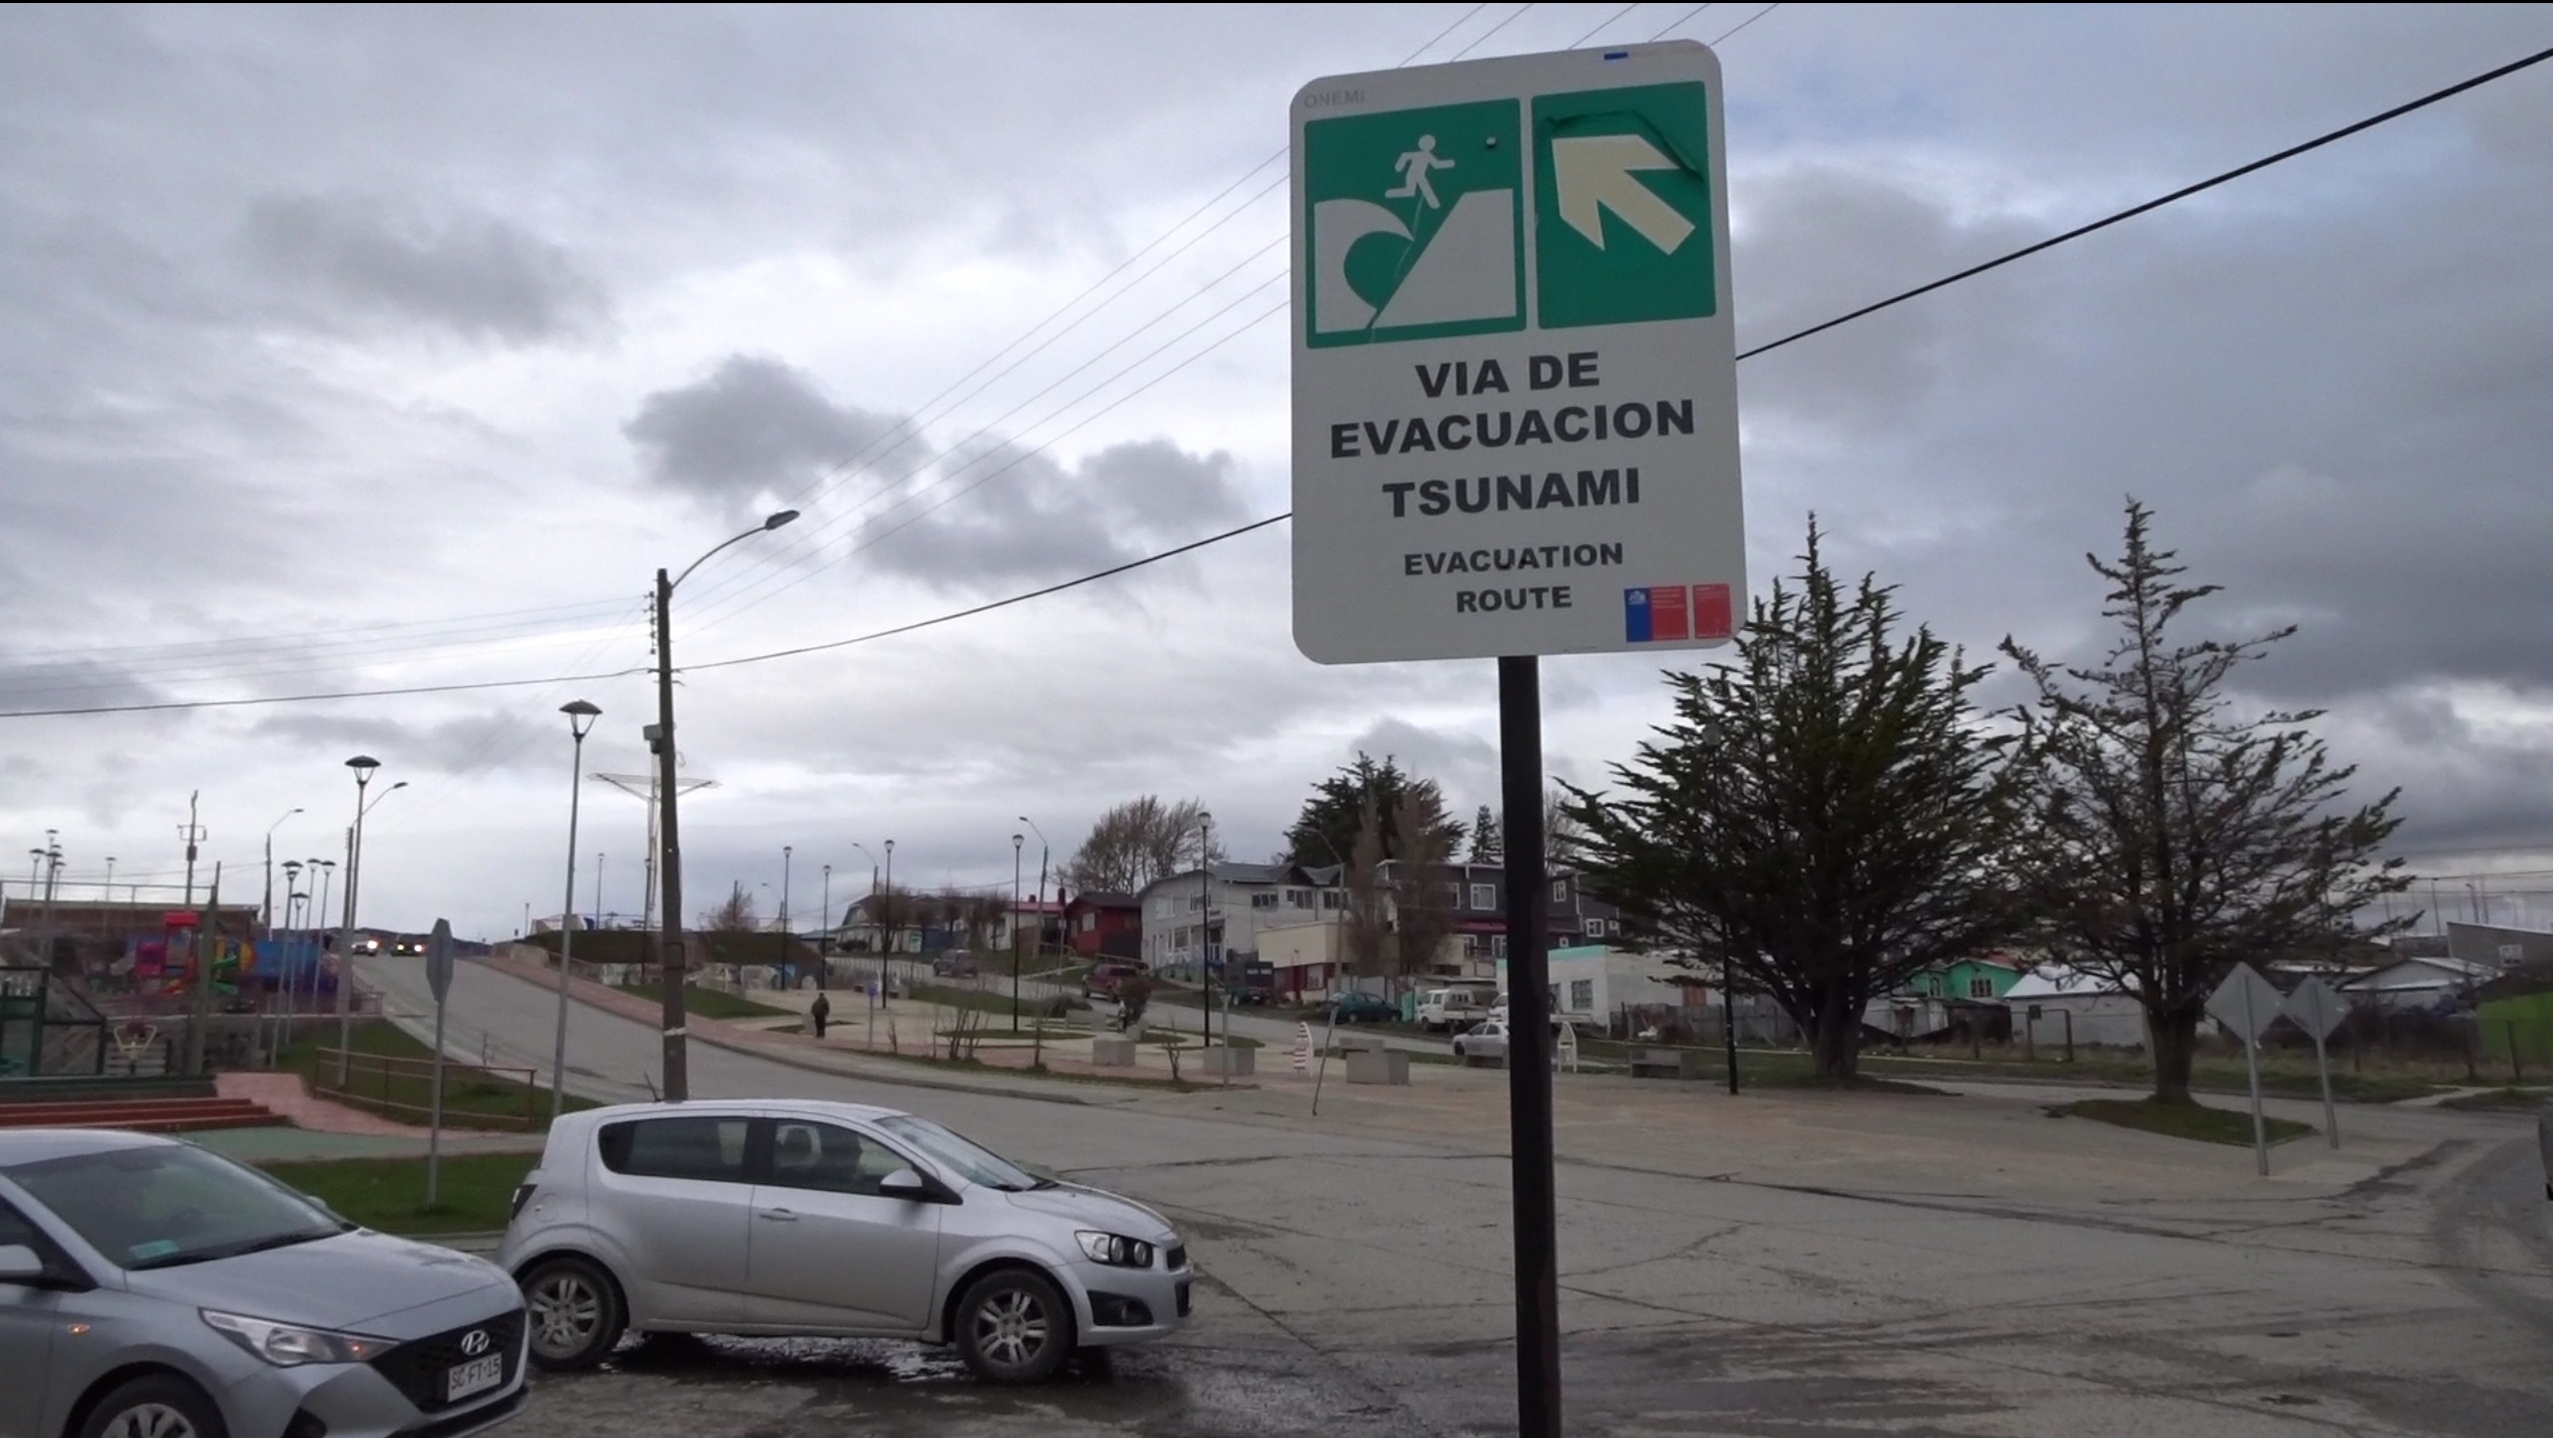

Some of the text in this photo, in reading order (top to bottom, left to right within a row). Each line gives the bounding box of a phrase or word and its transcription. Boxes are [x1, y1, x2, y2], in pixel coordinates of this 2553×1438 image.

[1304, 90, 1365, 109] ONEMI
[1415, 351, 1600, 398] VIA DE
[1330, 398, 1695, 459] EVACUACION
[1382, 467, 1640, 518] TSUNAMI
[1404, 542, 1624, 576] EVACUATION
[1456, 585, 1573, 613] ROUTE
